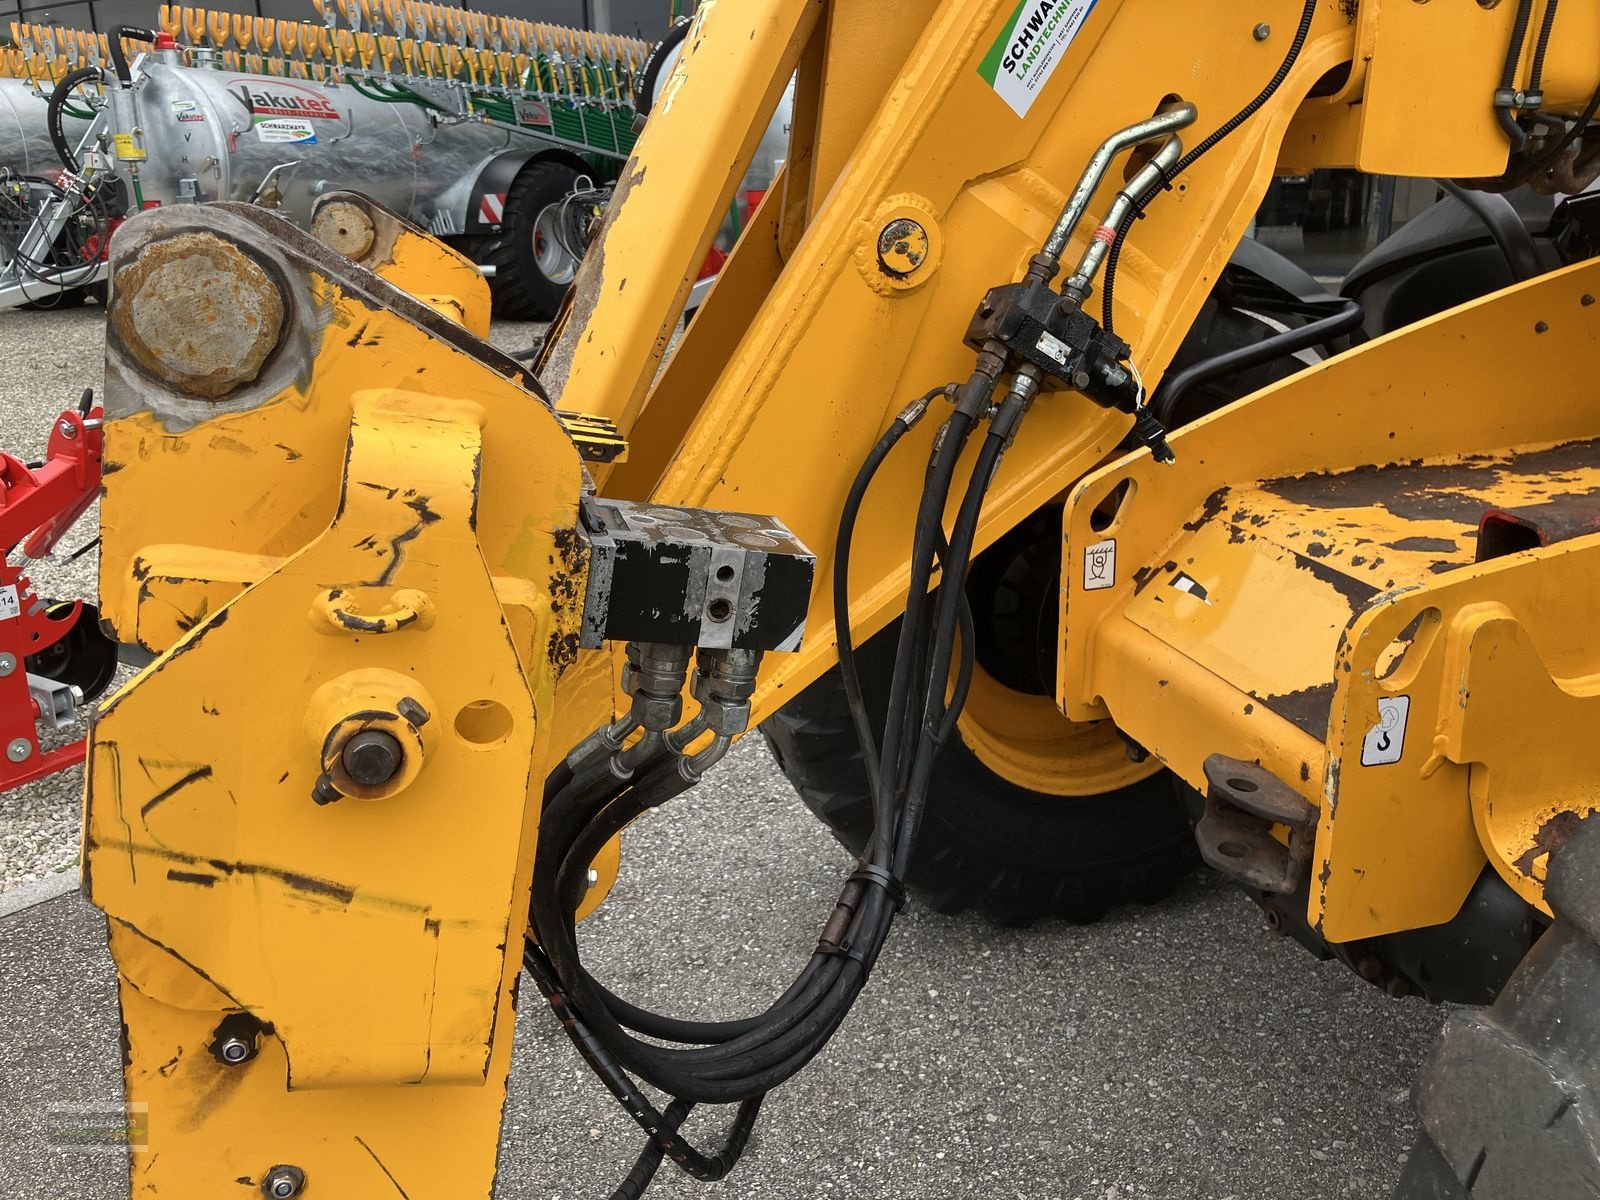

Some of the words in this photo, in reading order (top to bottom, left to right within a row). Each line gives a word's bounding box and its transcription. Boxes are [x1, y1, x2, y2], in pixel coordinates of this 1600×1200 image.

[1003, 0, 1058, 74] SCHWA
[1016, 0, 1072, 80] LANDTECHNI
[226, 85, 337, 114] Vakutec
